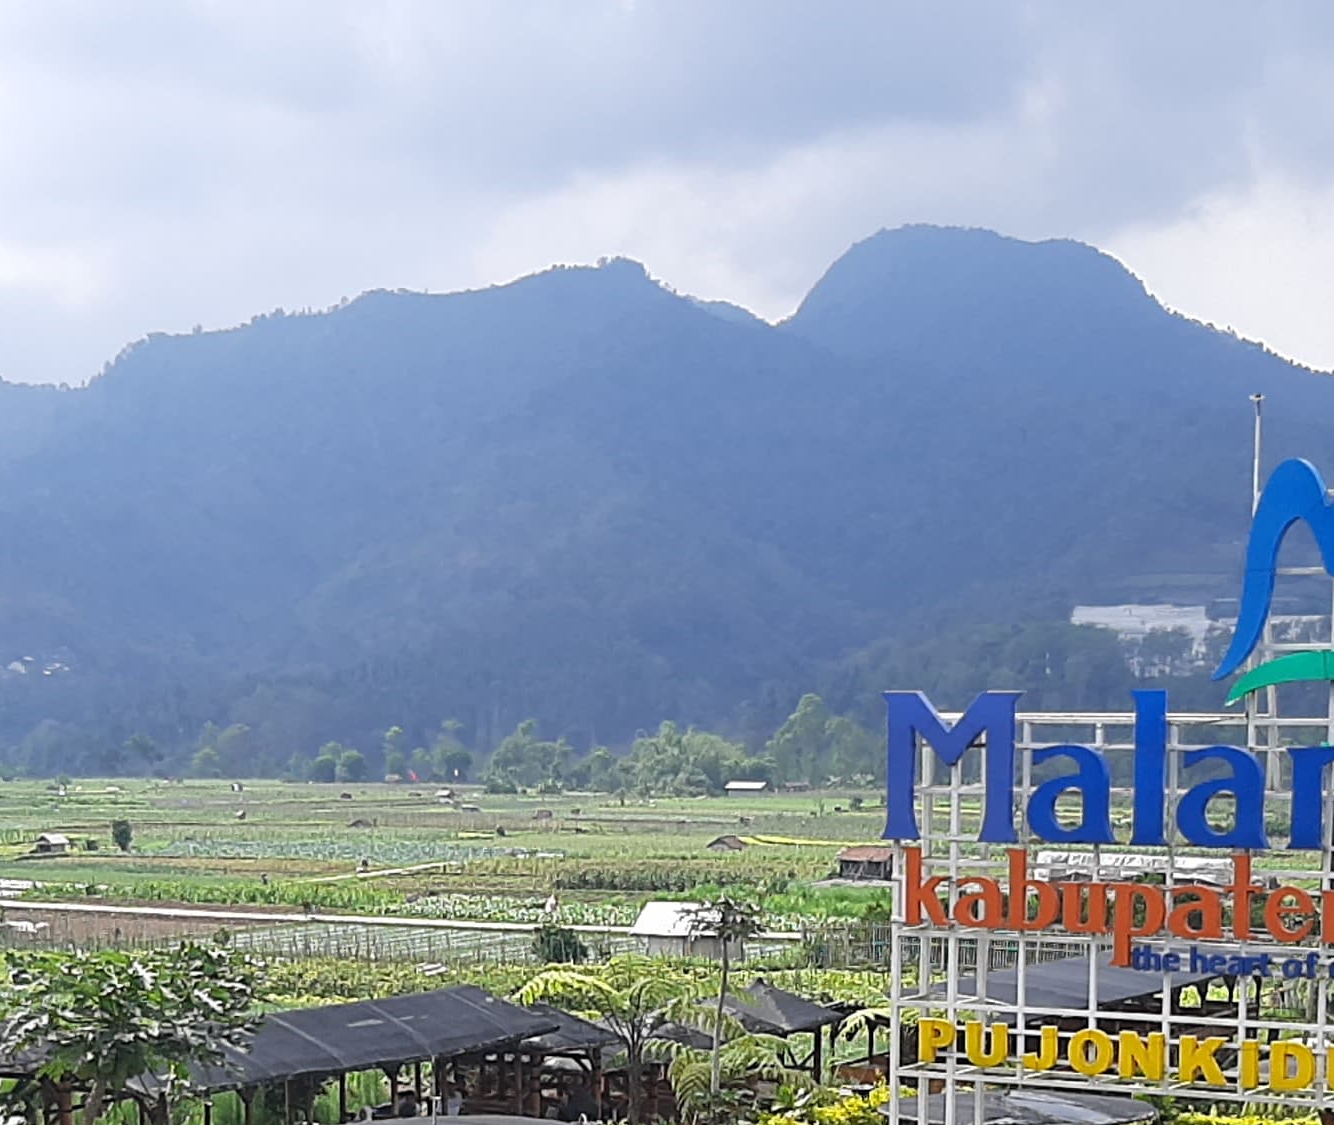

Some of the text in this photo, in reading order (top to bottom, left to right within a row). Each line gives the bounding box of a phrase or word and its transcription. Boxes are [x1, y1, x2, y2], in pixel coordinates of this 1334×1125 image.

[1131, 945, 1180, 973] the
[1189, 946, 1272, 977] heart
[1282, 952, 1317, 980] of
